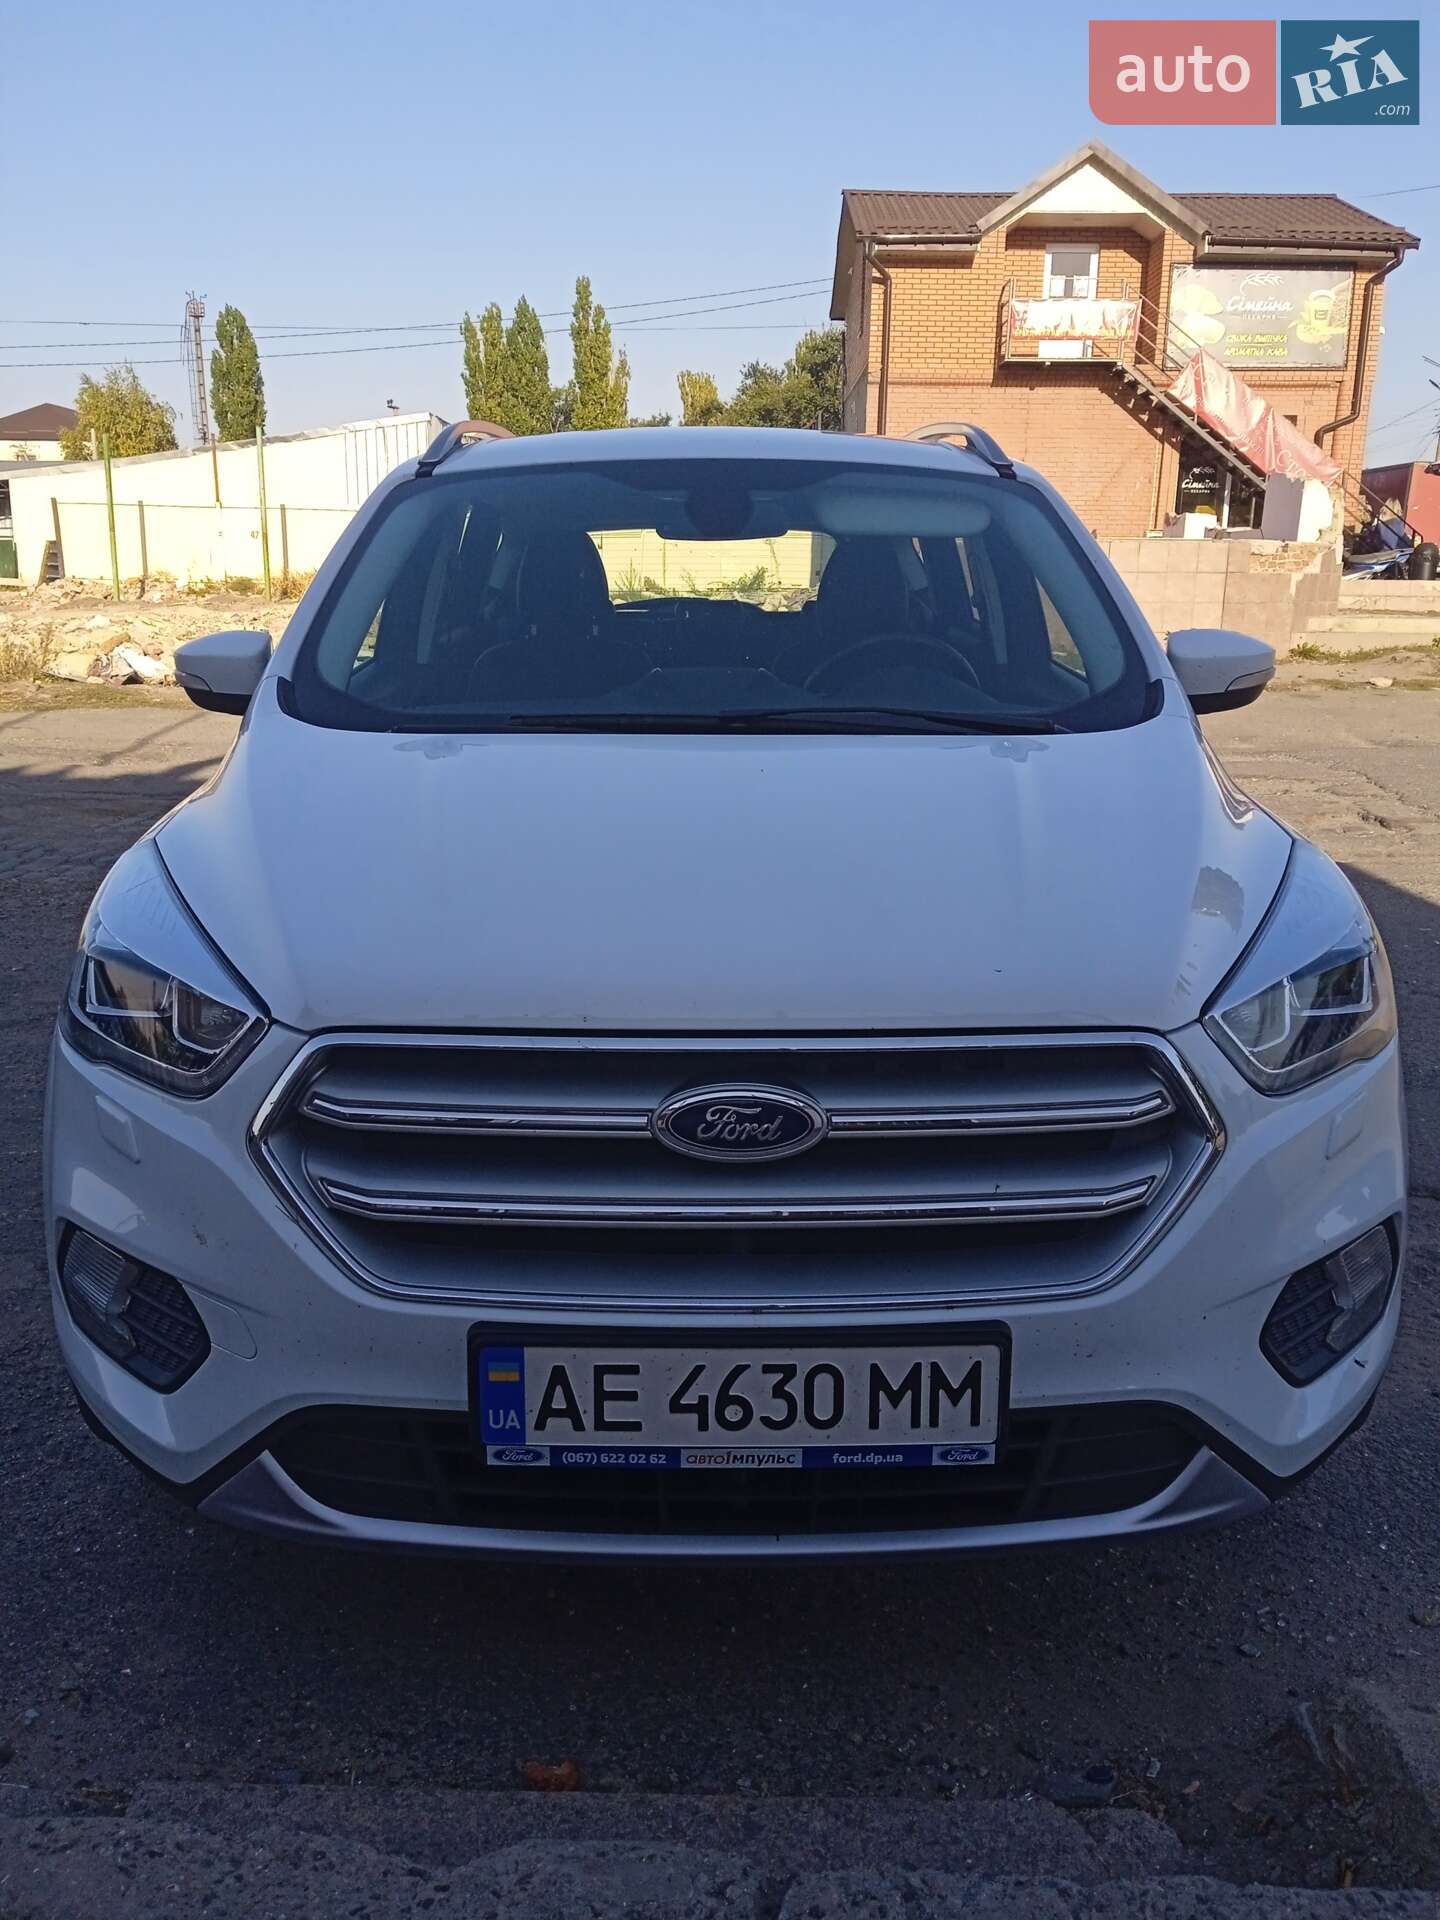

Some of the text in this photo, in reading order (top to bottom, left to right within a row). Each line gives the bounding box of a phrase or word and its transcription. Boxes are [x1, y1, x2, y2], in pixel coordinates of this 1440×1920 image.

[697, 1105, 783, 1141] Ford
[533, 1361, 982, 1433] AE 4630 MM
[488, 1409, 520, 1430] UA
[502, 1448, 535, 1462] Ford
[562, 1451, 667, 1465] (067) 622 02 62
[832, 1452, 904, 1465] ford.dp.ua
[947, 1447, 980, 1462] Ford
